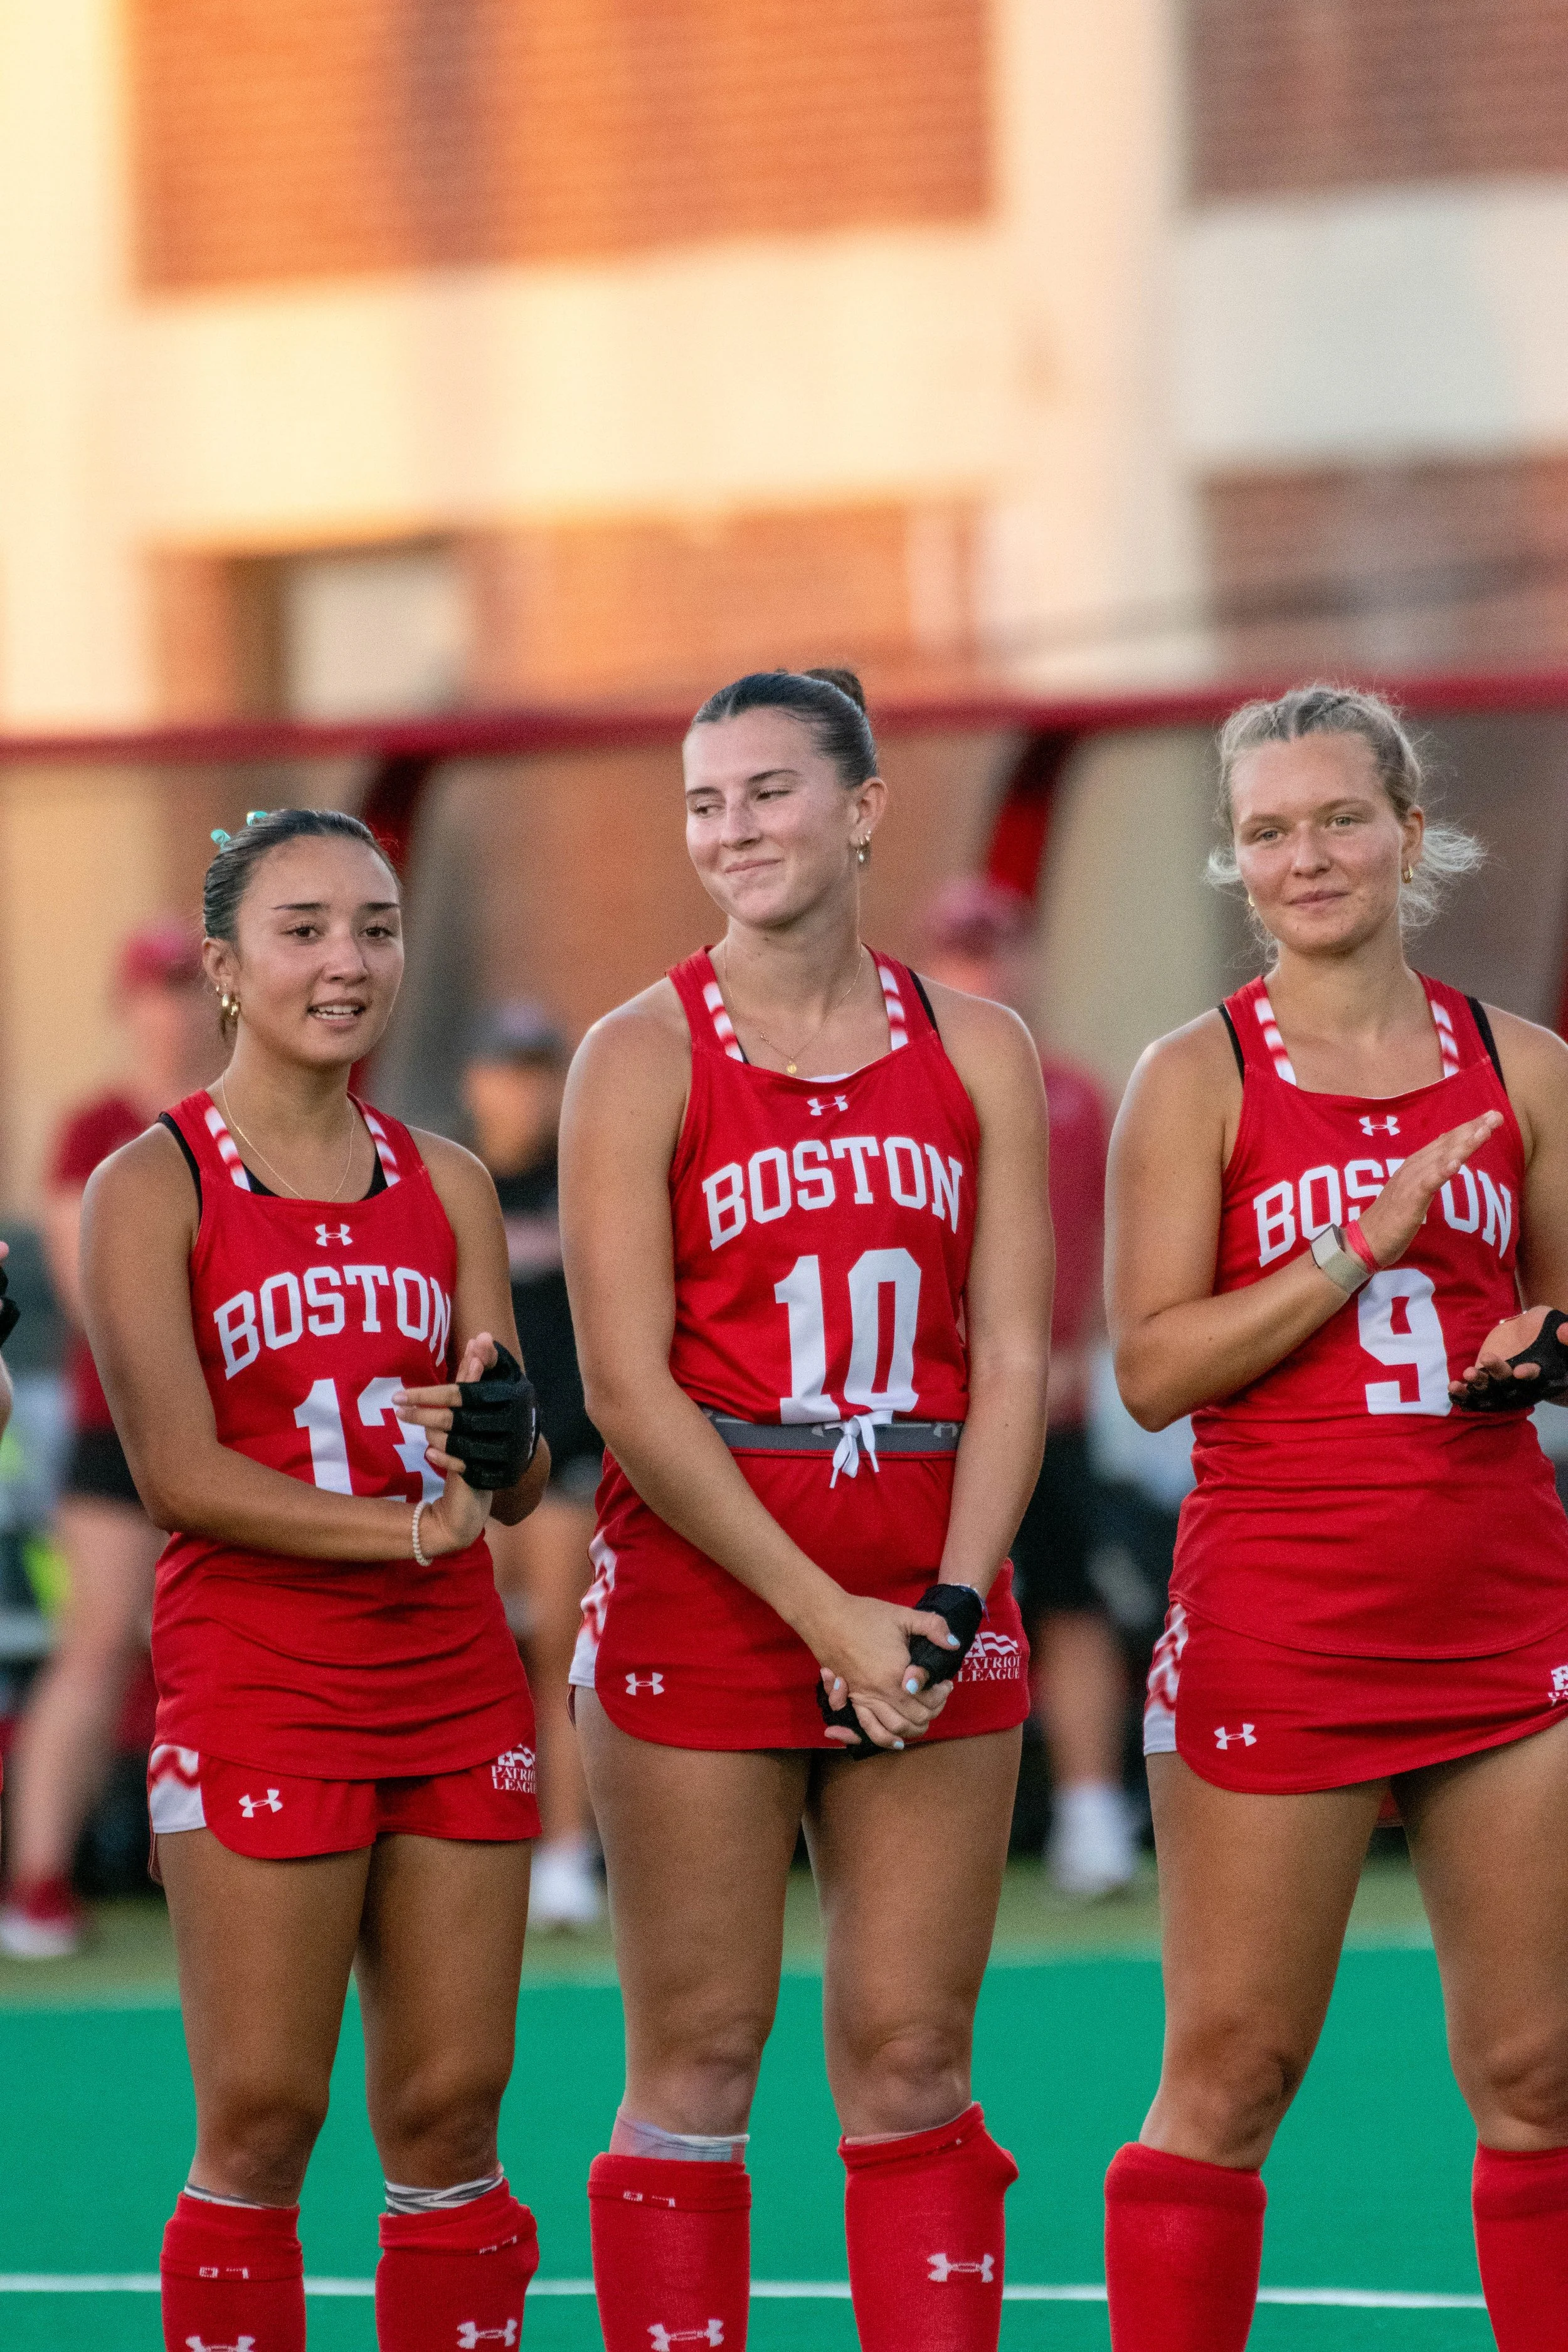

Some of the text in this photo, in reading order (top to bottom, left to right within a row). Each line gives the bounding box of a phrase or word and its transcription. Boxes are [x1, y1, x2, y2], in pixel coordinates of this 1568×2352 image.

[702, 1136, 963, 1251] BOSTON
[213, 1265, 451, 1380] BOSTON
[774, 1248, 922, 1424] 10
[1357, 1268, 1452, 1416] 9
[957, 1668, 1020, 1683] LEAGUE
